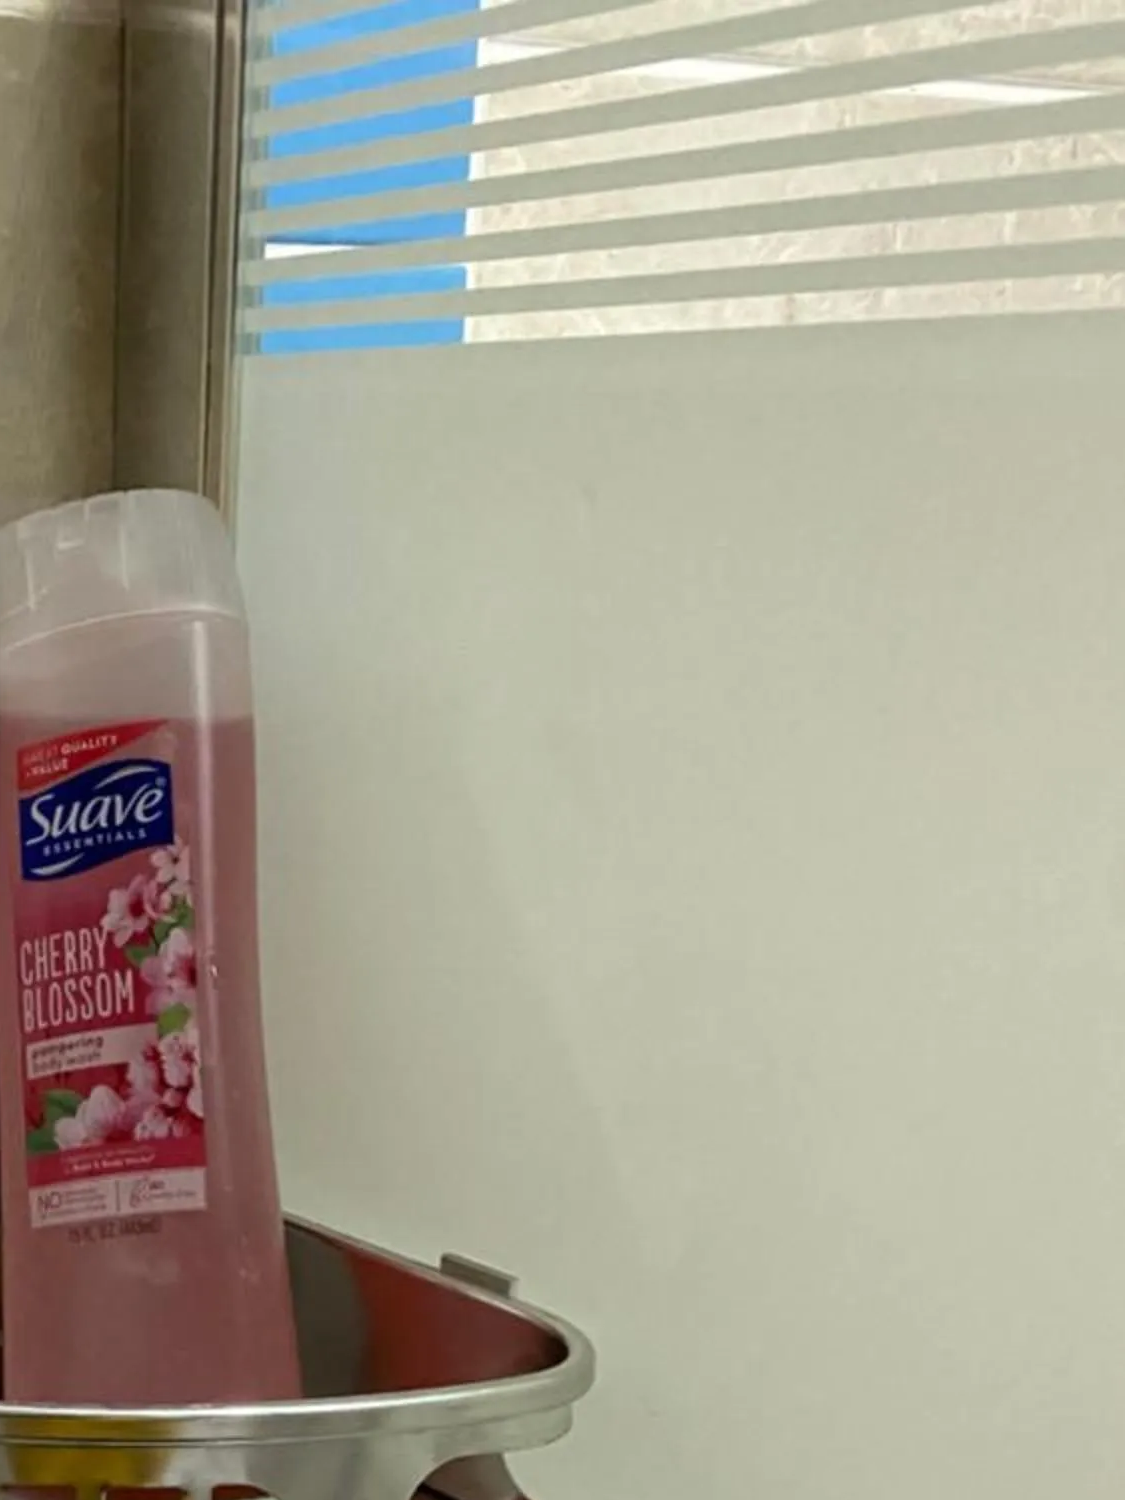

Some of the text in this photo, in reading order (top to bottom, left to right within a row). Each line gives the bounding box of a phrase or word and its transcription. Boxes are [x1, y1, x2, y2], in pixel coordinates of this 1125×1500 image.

[61, 735, 118, 755] QUALITY
[25, 783, 164, 846] Suave
[43, 828, 147, 857] ESSENTIALS
[20, 927, 108, 986] CHERRY
[22, 968, 135, 1034] BLOSSOM
